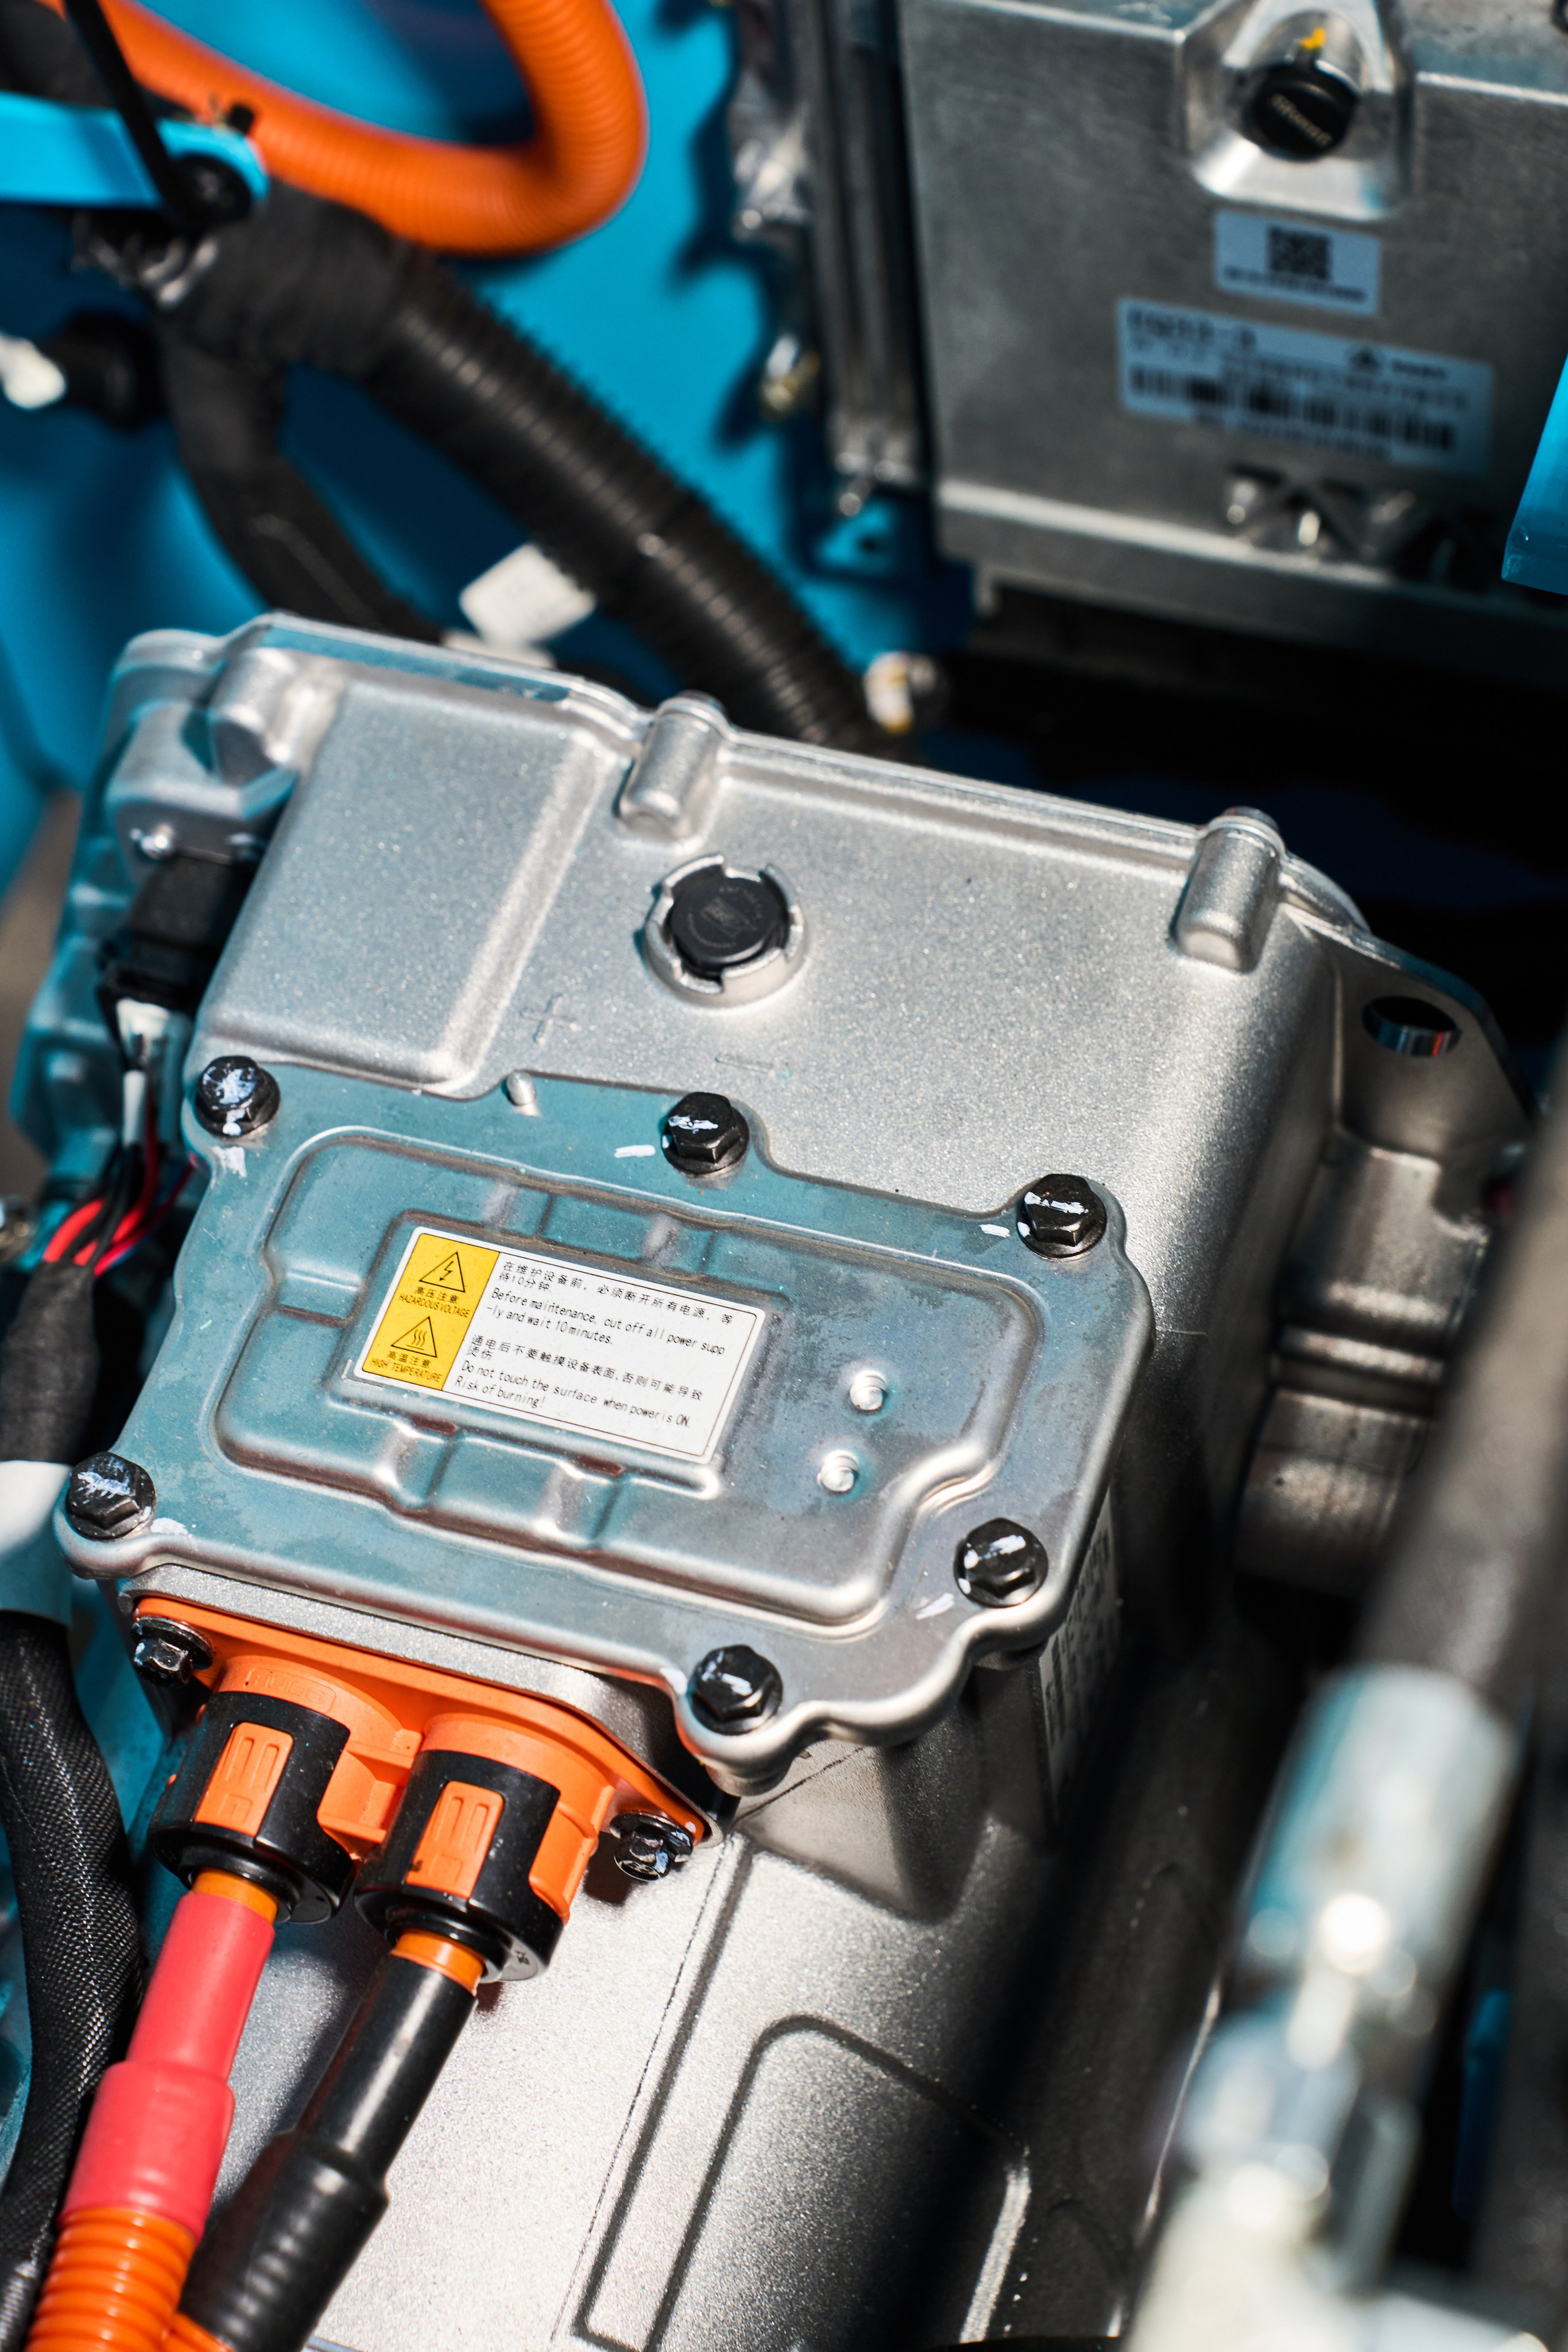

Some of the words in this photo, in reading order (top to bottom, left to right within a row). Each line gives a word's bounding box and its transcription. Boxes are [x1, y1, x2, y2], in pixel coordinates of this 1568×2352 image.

[399, 1294, 440, 1310] HAZARDOUS
[440, 1304, 470, 1318] VOLTAGE
[415, 1286, 459, 1304] 高压注意
[492, 1287, 528, 1306] Before
[604, 1319, 623, 1330] cut
[625, 1322, 646, 1333] off
[646, 1328, 665, 1339] all
[666, 1335, 698, 1347] power
[701, 1343, 725, 1355] supp
[506, 1312, 527, 1322] and
[527, 1317, 552, 1329] wait
[372, 1358, 390, 1367] HIGH
[392, 1363, 443, 1382] TEMPERATURE
[386, 1351, 432, 1368] 高温注意
[455, 1376, 480, 1391] Risk
[482, 1384, 497, 1394] of
[497, 1387, 546, 1409] burning!
[462, 1360, 475, 1373] Do
[477, 1368, 496, 1378] not
[499, 1371, 529, 1385] touch
[532, 1379, 549, 1391] the
[553, 1387, 598, 1403] surface
[603, 1398, 628, 1411] when
[629, 1406, 661, 1419] power
